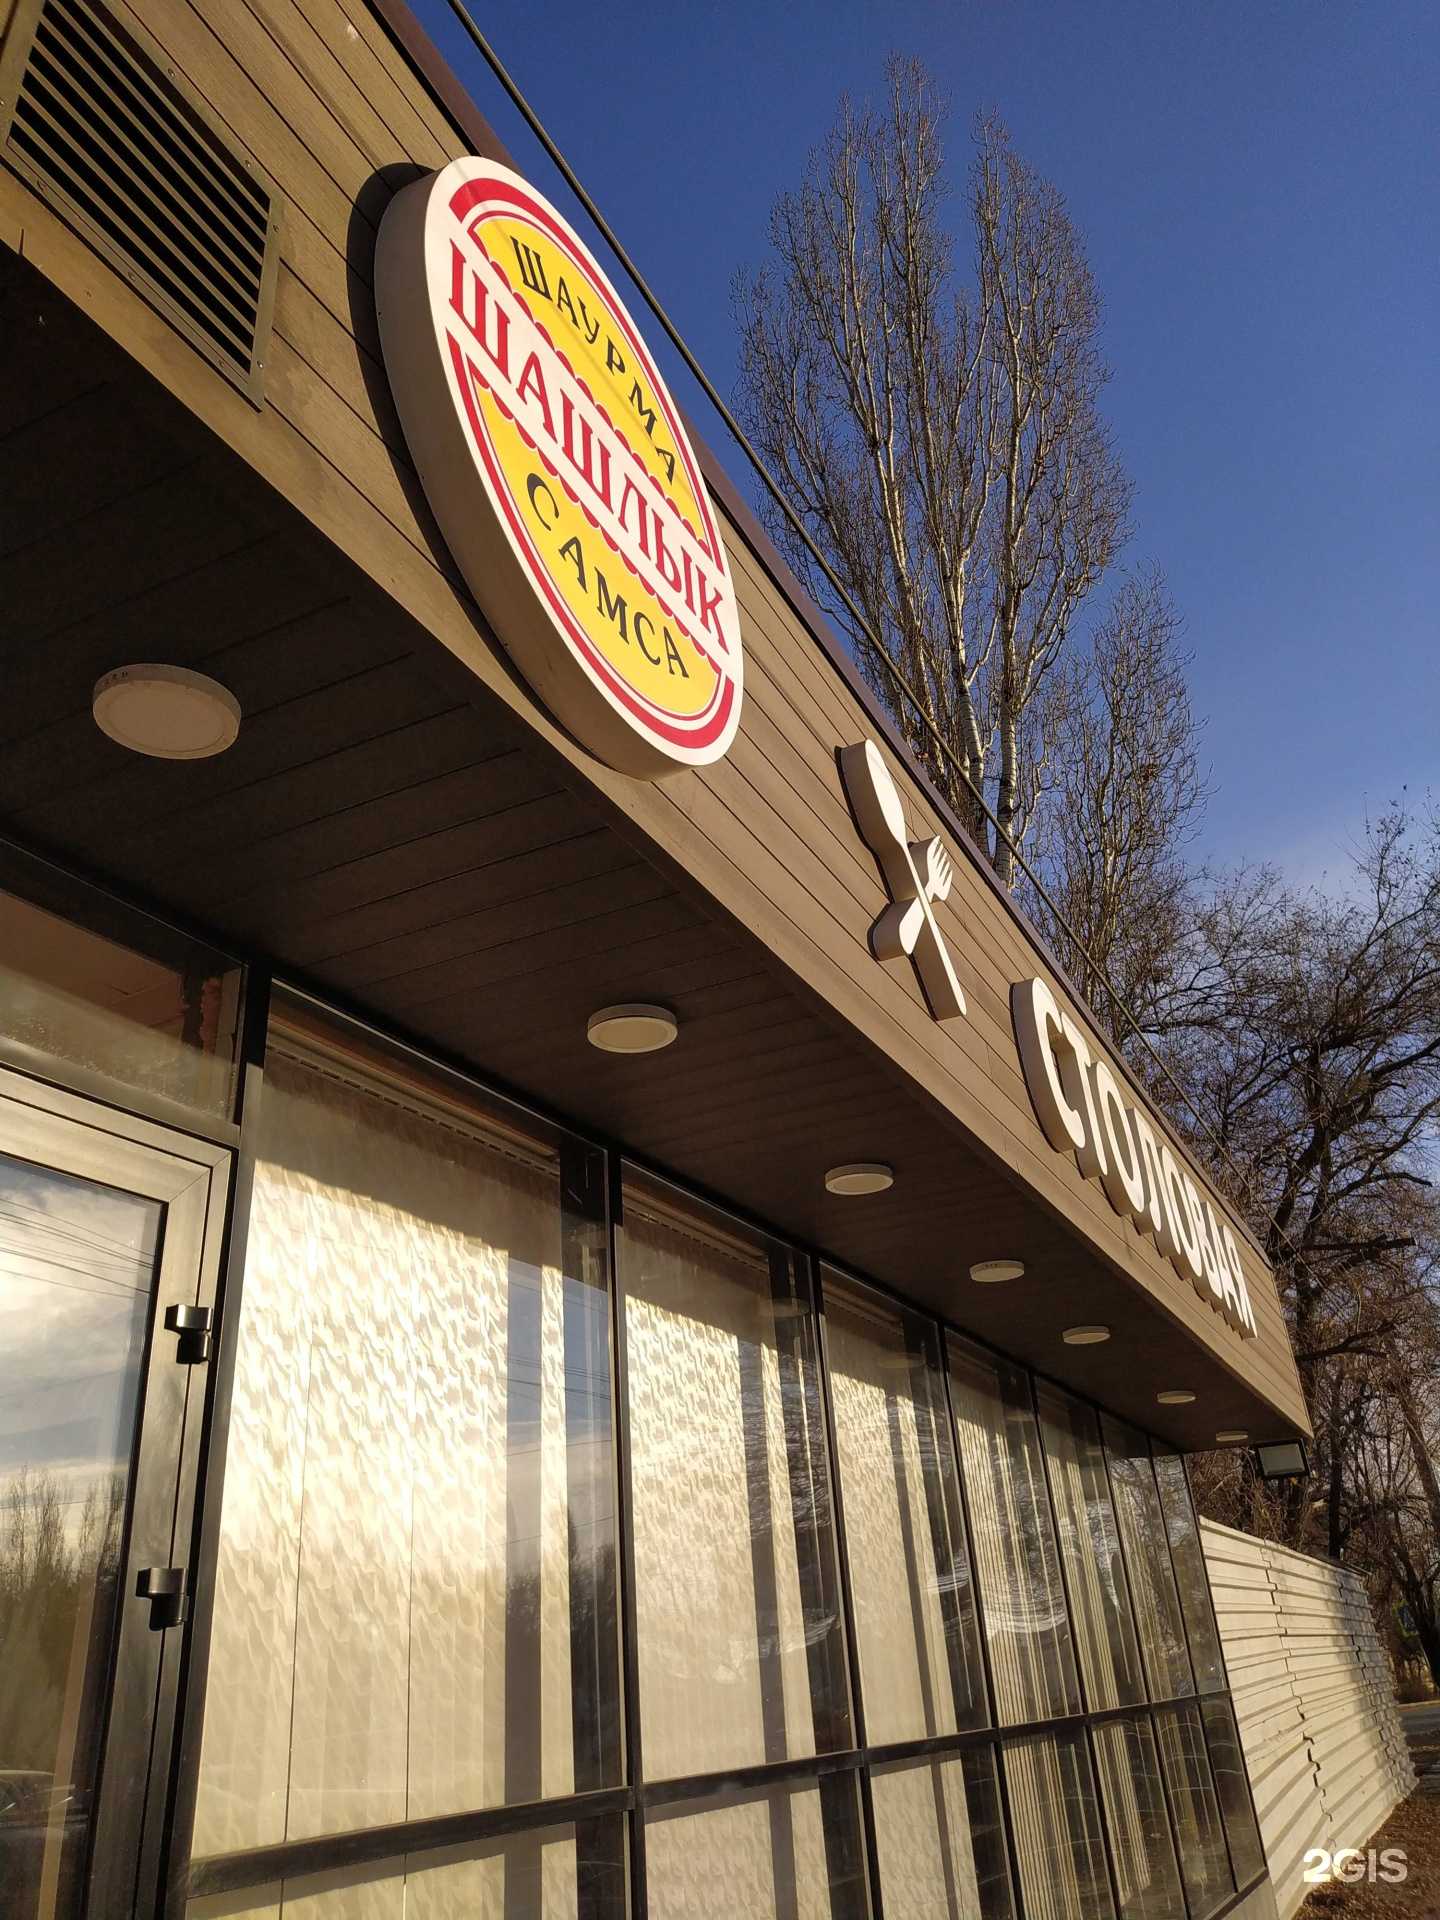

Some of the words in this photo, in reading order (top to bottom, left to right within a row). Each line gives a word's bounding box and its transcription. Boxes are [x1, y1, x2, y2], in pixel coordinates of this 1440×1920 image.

[449, 238, 730, 654] ШАШЛЫК
[510, 236, 676, 482] ШАУРМА
[526, 472, 690, 679] САМСА
[1032, 977, 1258, 1338] СТОЛОВАЯ
